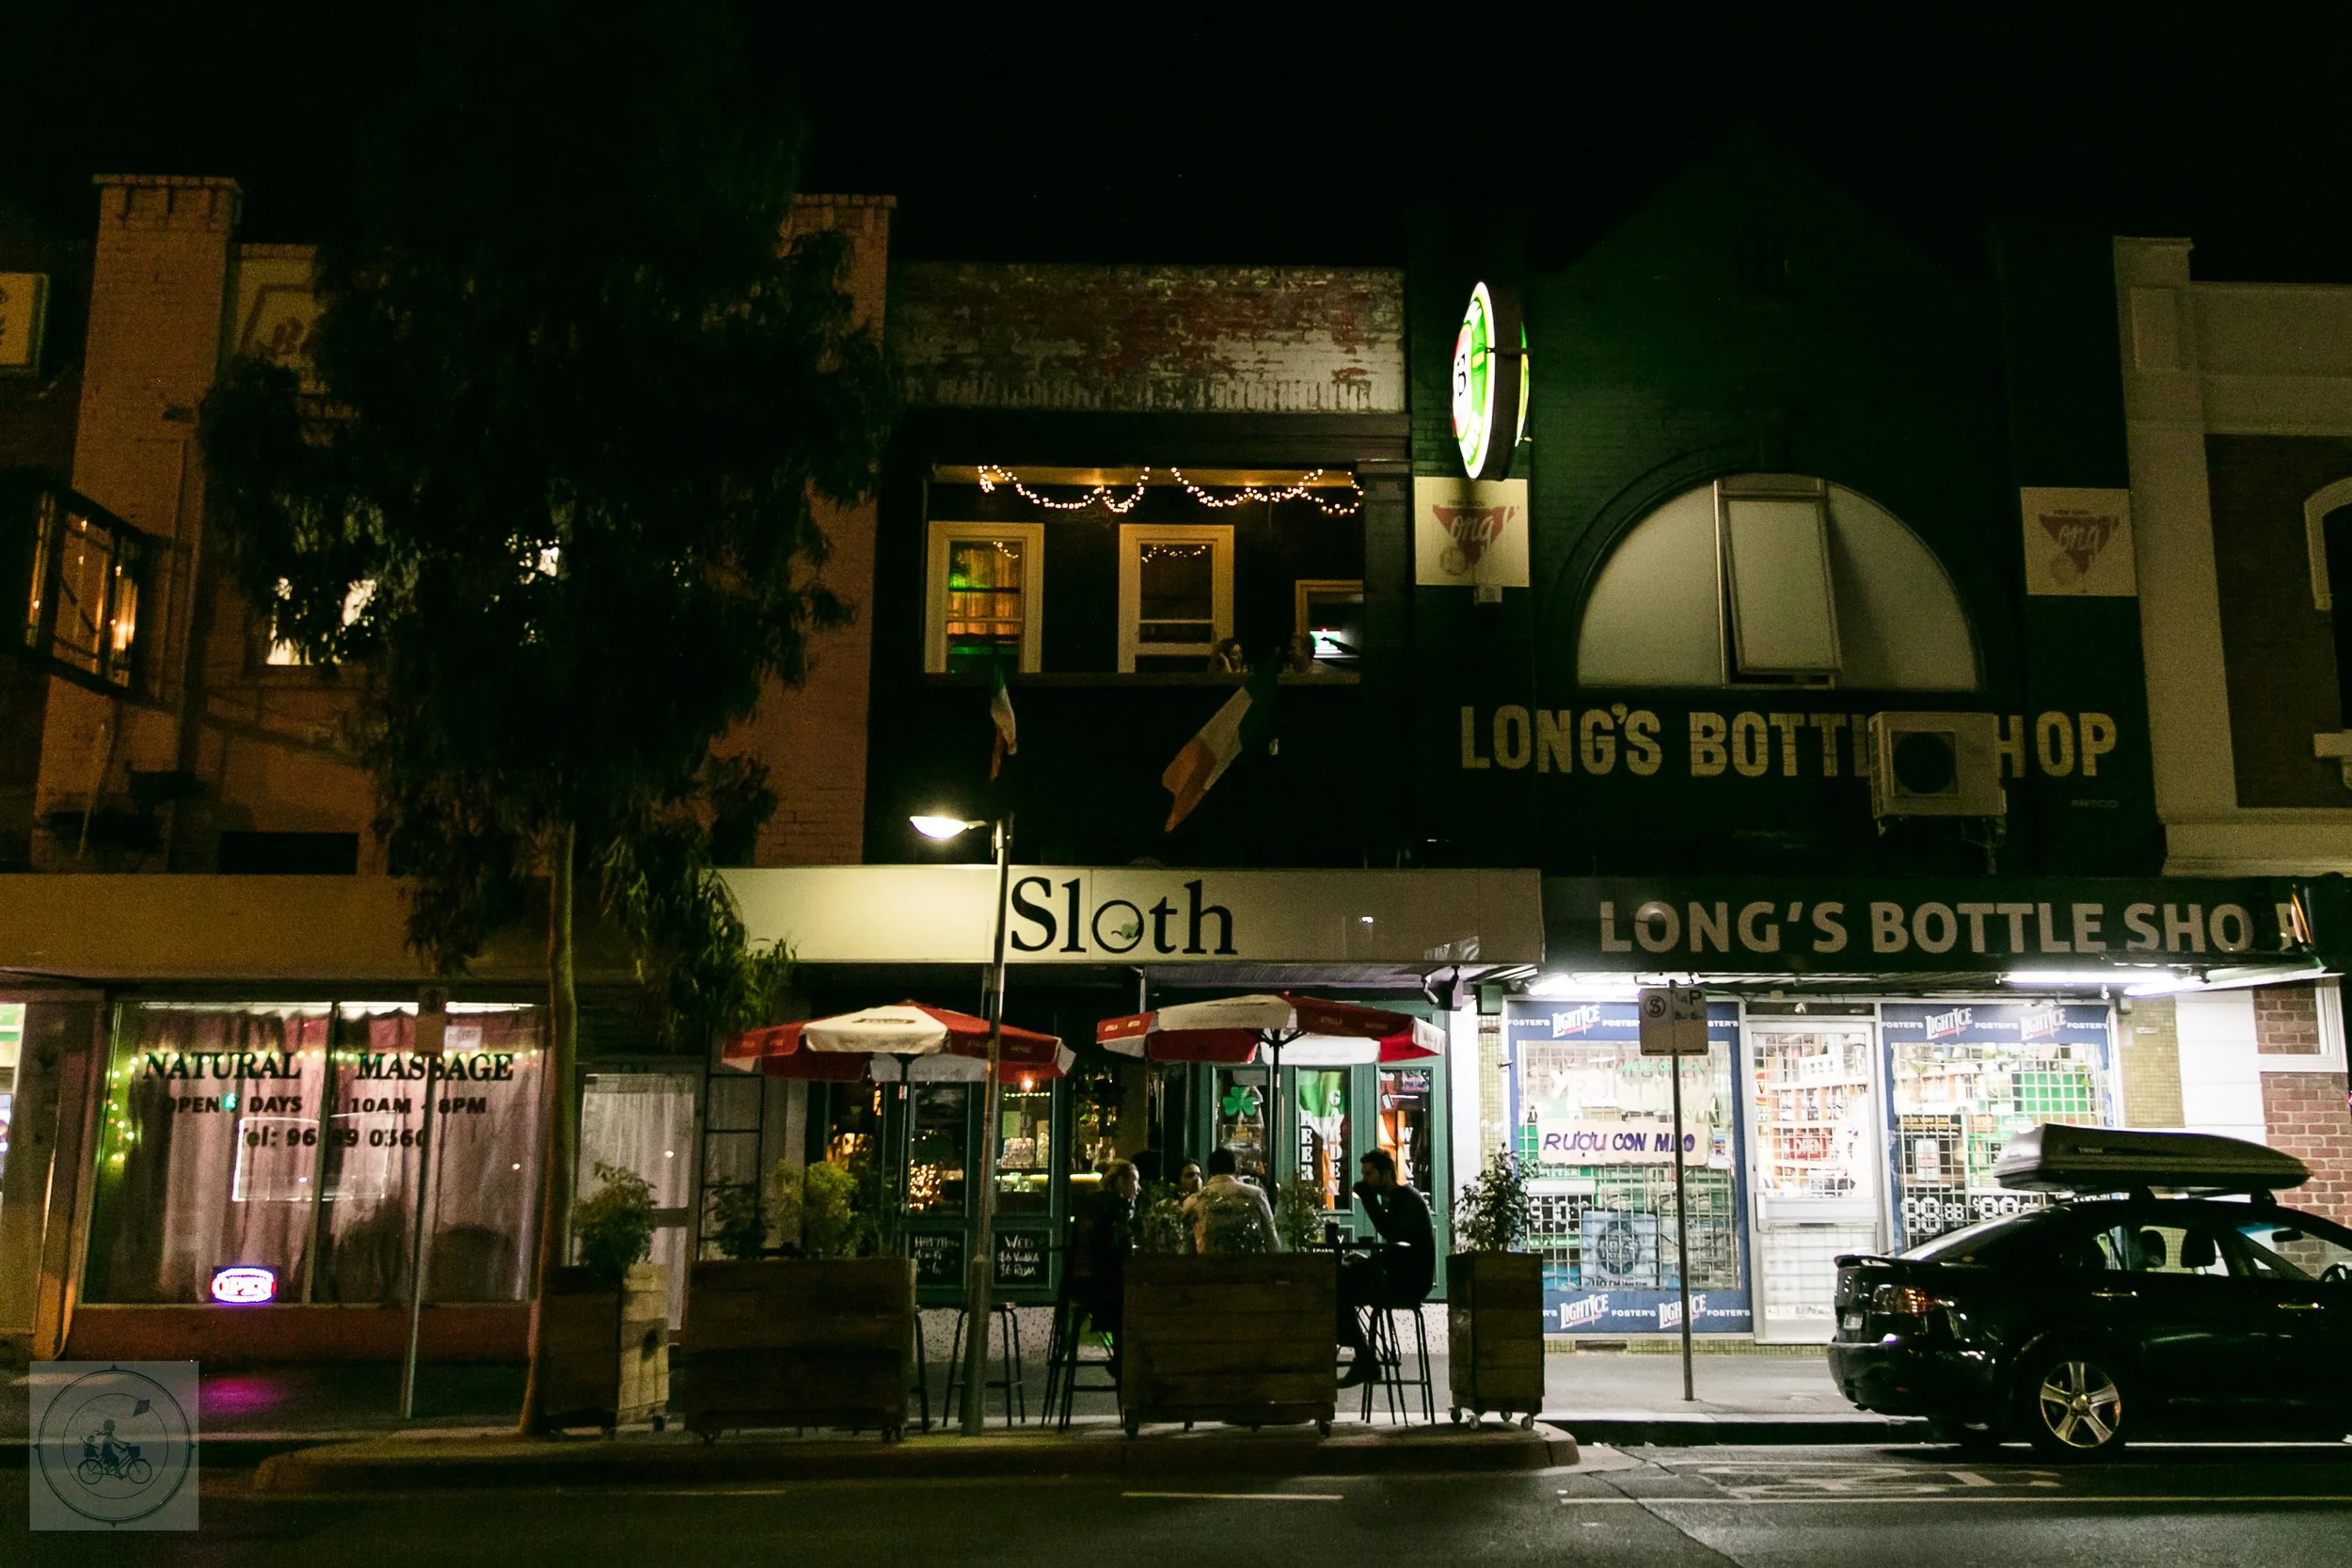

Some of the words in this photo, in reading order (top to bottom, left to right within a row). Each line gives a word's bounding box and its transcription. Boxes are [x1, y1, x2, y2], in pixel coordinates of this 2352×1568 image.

[1460, 703, 1662, 776] LONG'S
[1689, 711, 1871, 778] BOTTL
[1993, 710, 2118, 779] HOP
[1009, 876, 1239, 956] Sloth
[1599, 899, 1849, 953] LONG'S
[1871, 902, 2107, 953] BOTTLE
[1507, 1019, 1551, 1027] FOSTER'S
[1601, 1019, 1640, 1028] FOSTER'
[1707, 1020, 1739, 1028] STER'S
[1882, 1021, 1924, 1029] FOSTER'S
[1975, 1022, 2019, 1030] FOSTER'S
[143, 1052, 301, 1080] NATURAL
[355, 1052, 514, 1082] MASSAGE
[164, 1096, 220, 1114] OPEN
[249, 1097, 302, 1113] DAYS
[351, 1098, 412, 1114] 10AM
[438, 1097, 487, 1115] 8PM
[243, 1126, 278, 1148] el:
[1613, 1132, 1647, 1152] CON
[1400, 1127, 1415, 1187] WIN
[1612, 1309, 1656, 1318] FOSTER'S
[1707, 1309, 1751, 1318] FOSTER'S
